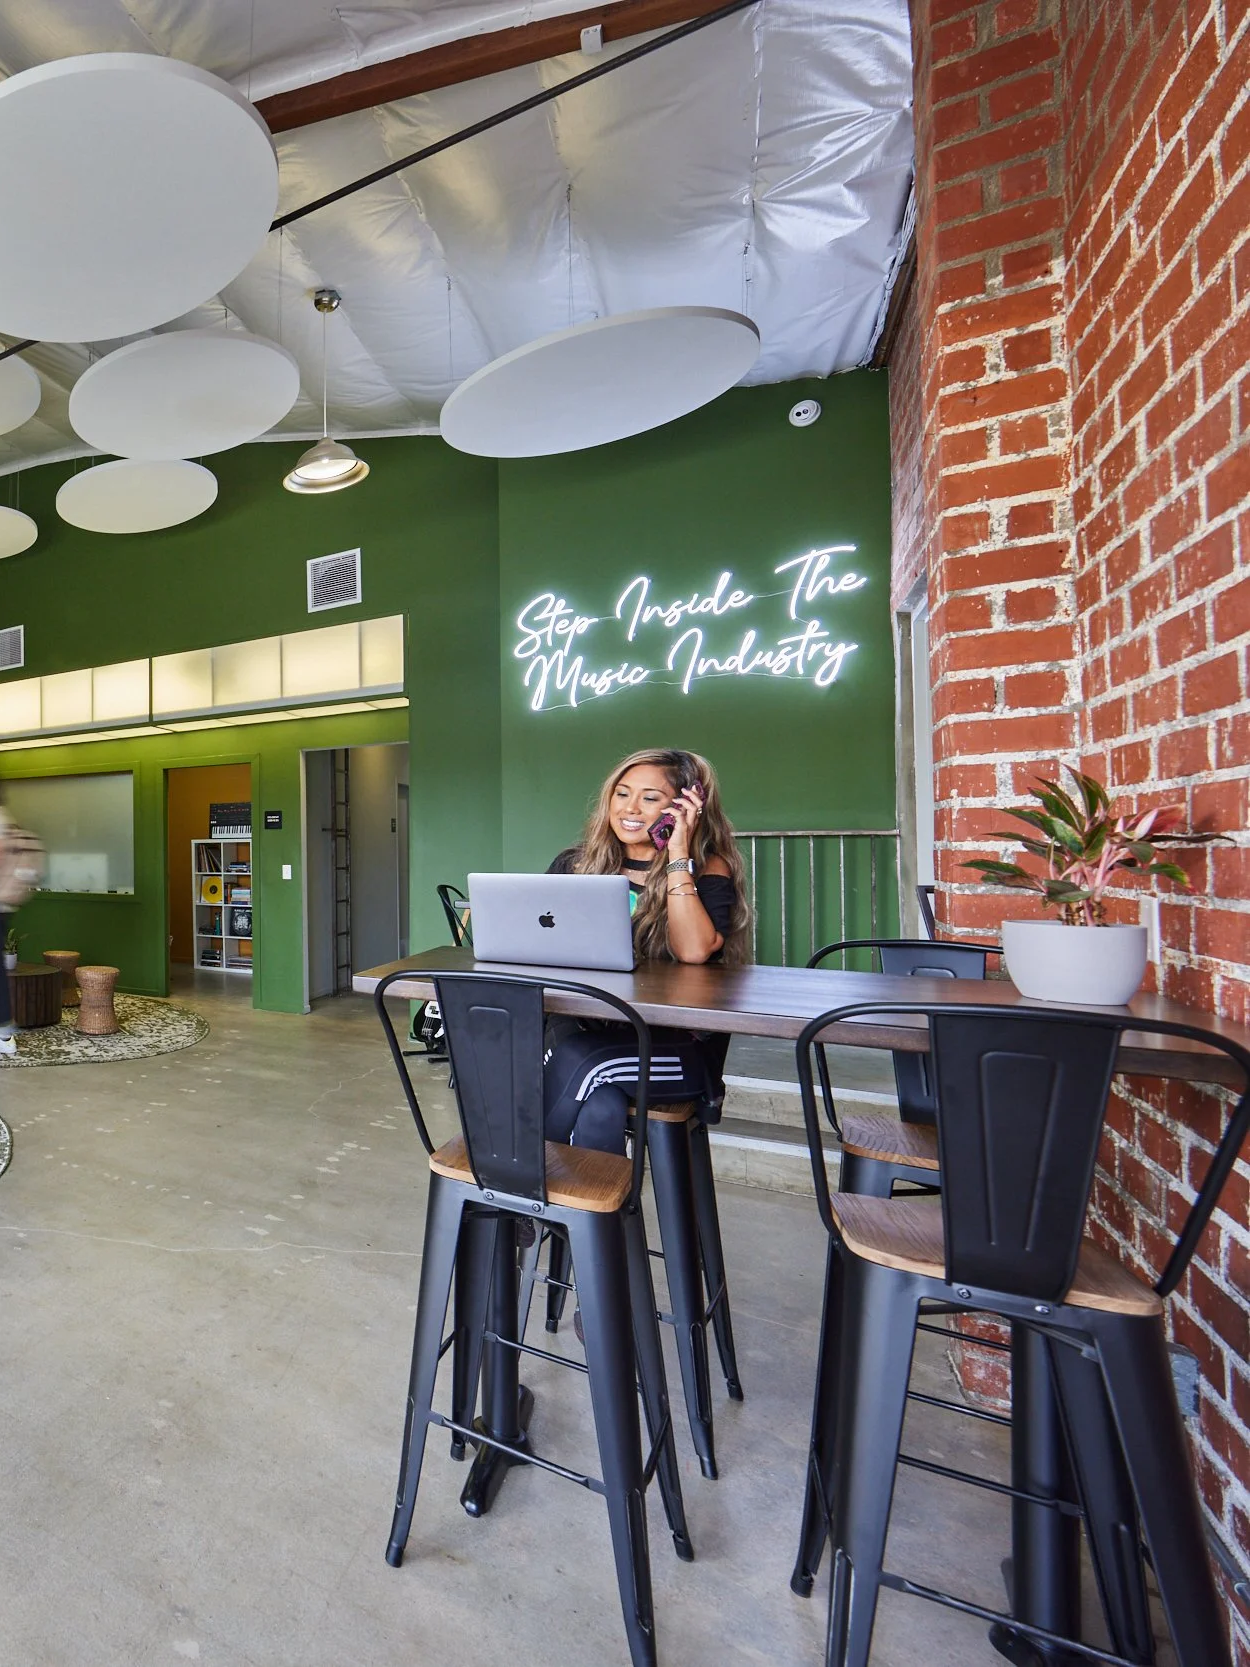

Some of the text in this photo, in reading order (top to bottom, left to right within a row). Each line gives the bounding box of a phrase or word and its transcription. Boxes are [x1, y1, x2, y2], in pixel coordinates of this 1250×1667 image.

[514, 543, 868, 658] Step Inside The
[524, 620, 858, 711] Music Industry
